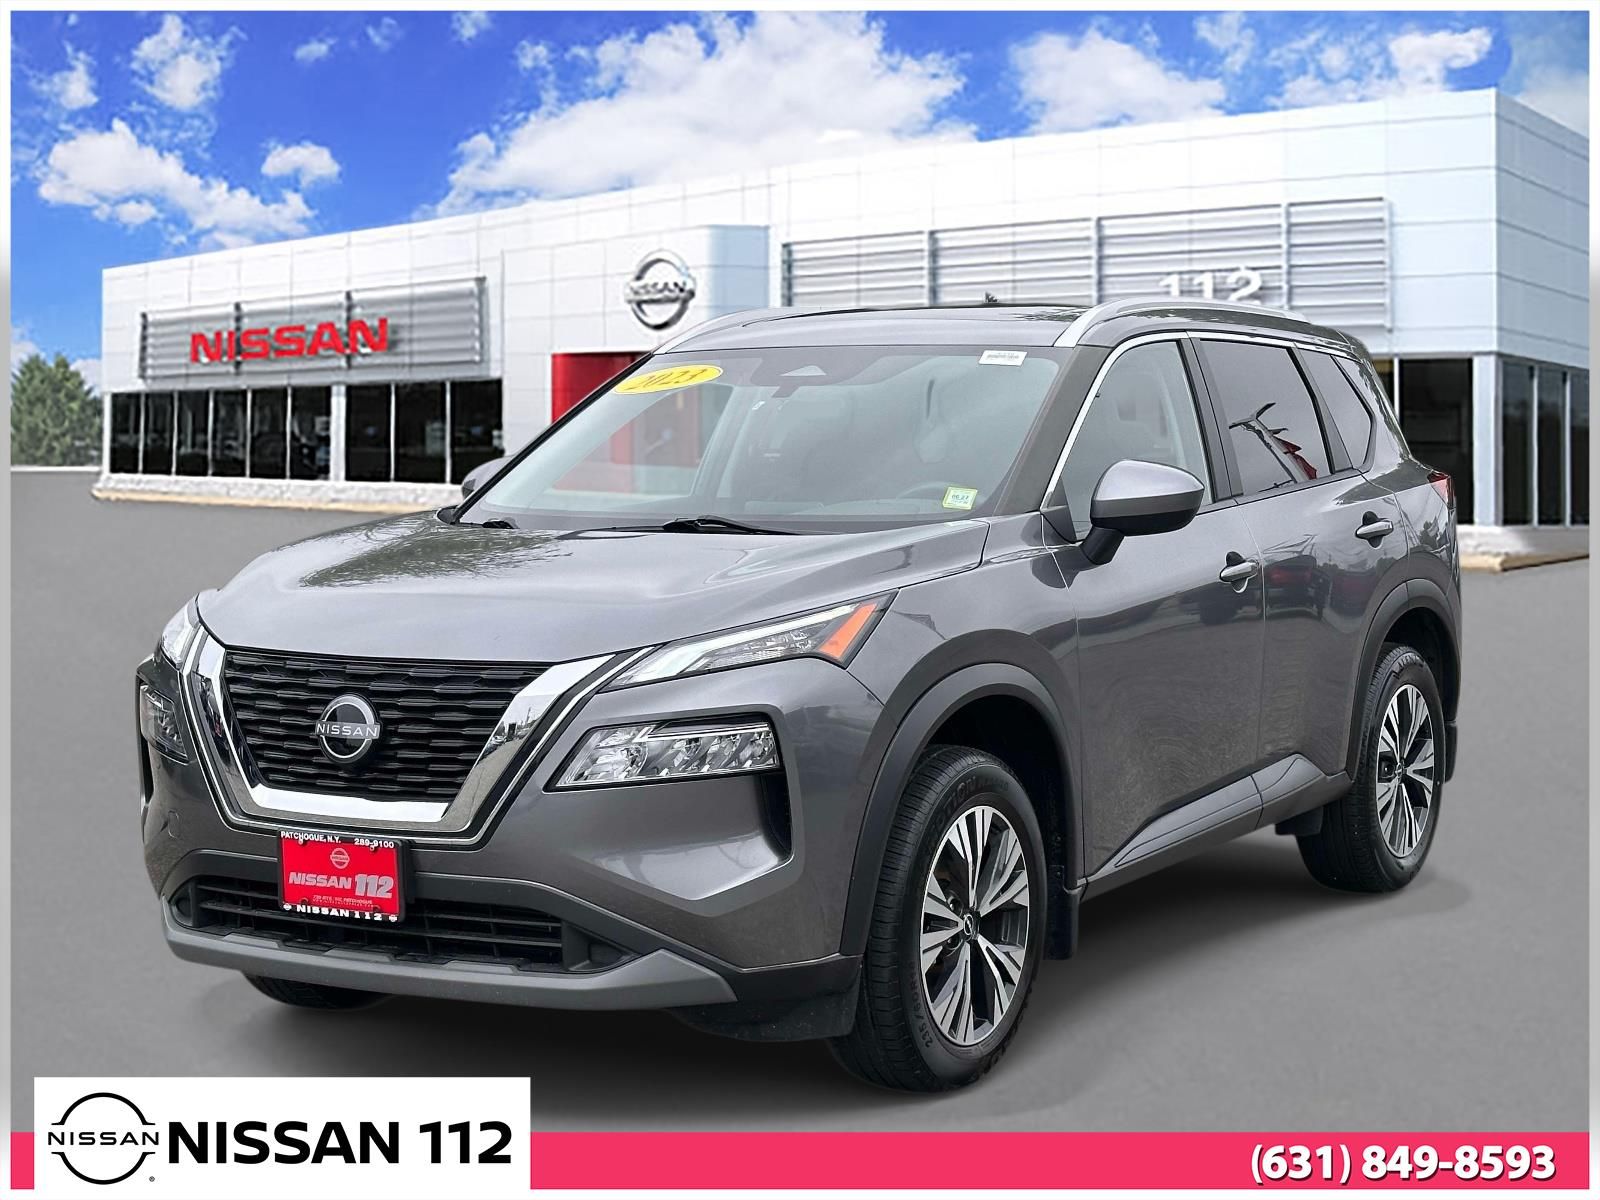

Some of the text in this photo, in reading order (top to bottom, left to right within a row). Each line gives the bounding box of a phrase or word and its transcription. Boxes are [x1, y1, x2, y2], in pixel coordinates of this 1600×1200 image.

[1158, 268, 1262, 304] 112
[190, 317, 389, 363] NISSAN
[316, 723, 378, 737] NISSAN
[354, 838, 395, 848] 289-9100
[288, 872, 394, 898] NISSAN 112
[296, 904, 383, 921] NISSAN 112
